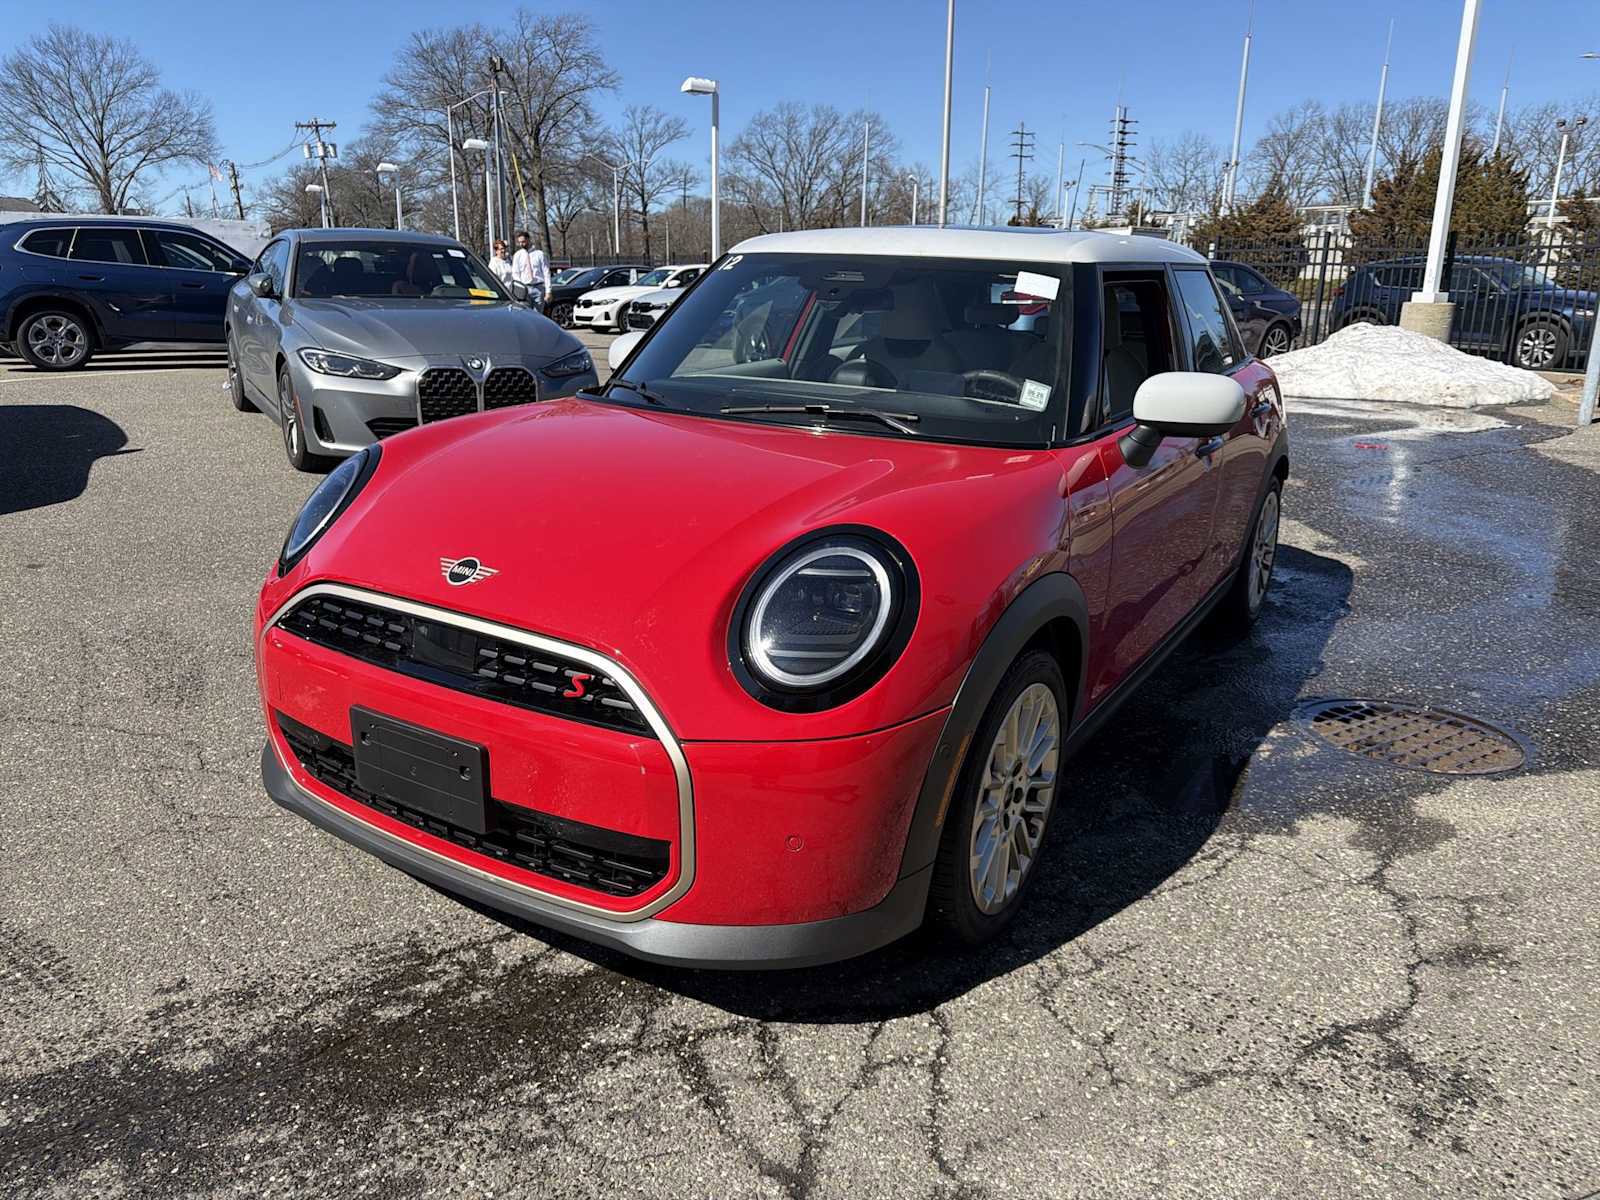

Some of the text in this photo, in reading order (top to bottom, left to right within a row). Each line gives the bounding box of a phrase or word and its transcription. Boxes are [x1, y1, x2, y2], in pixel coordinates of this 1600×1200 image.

[718, 255, 744, 271] 12
[451, 564, 475, 577] MINI
[563, 672, 592, 698] S
